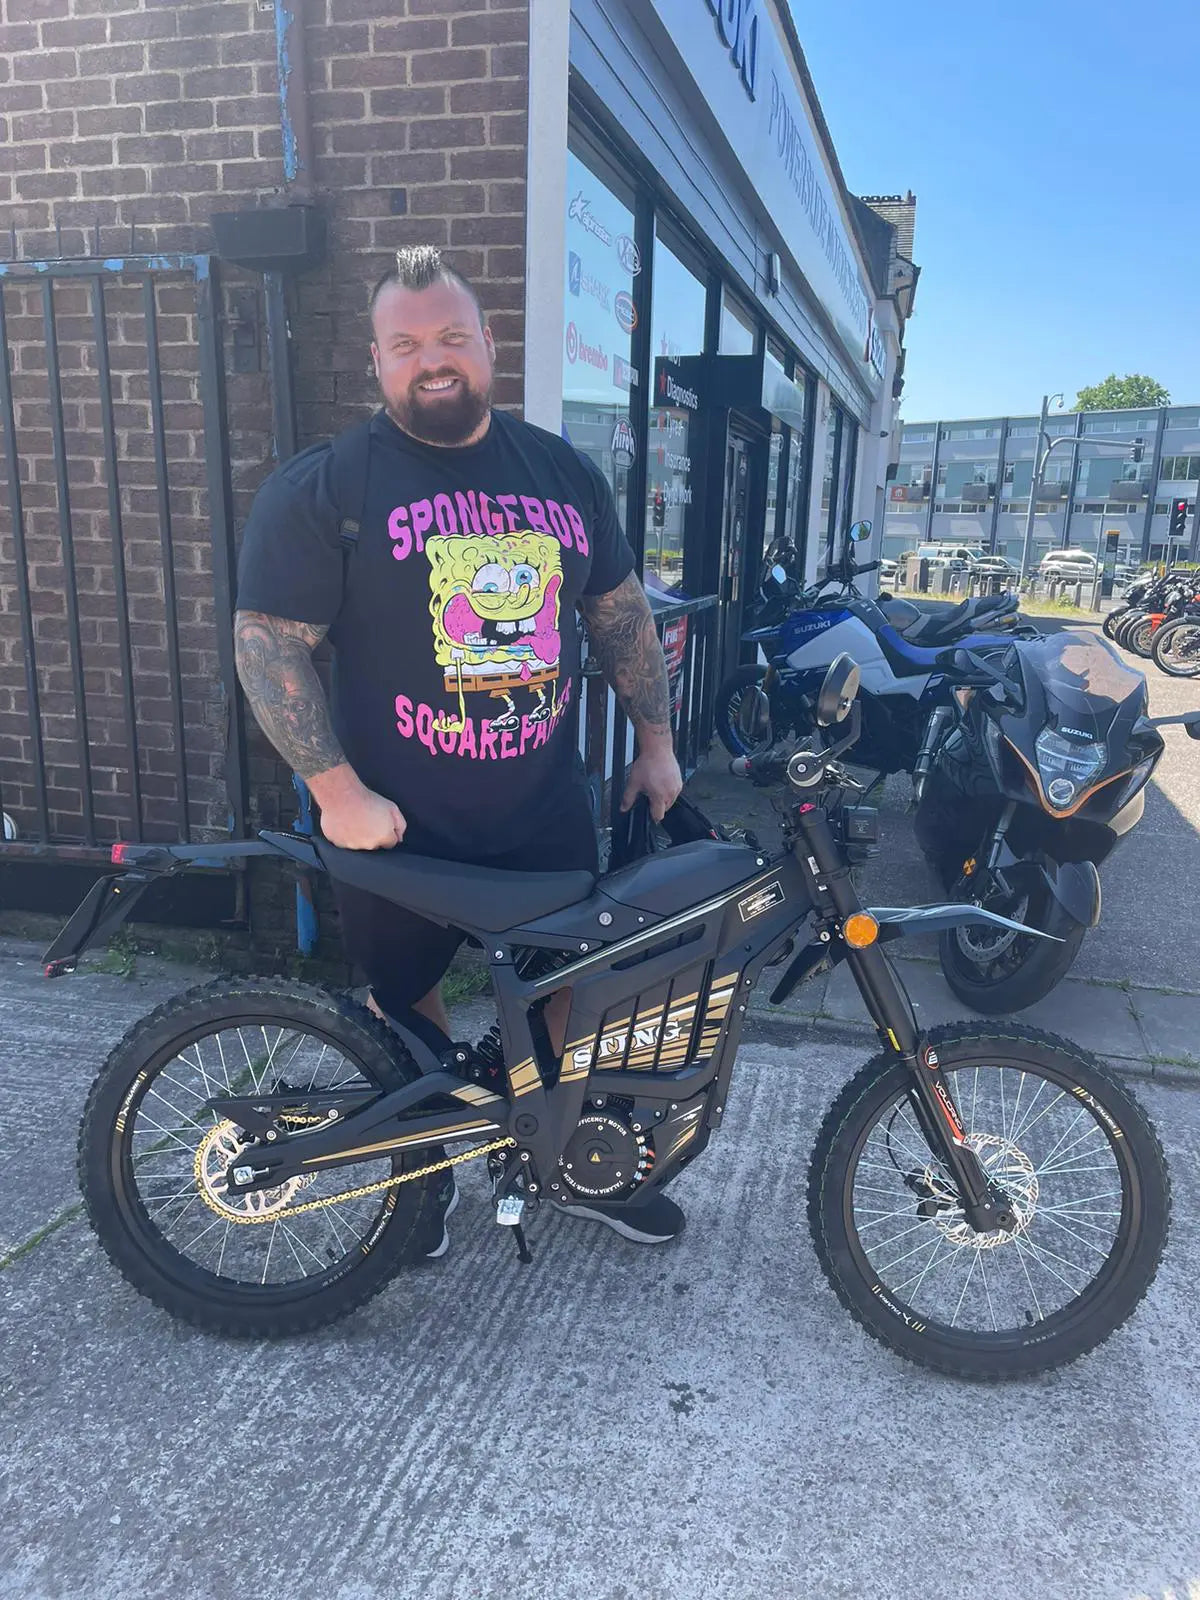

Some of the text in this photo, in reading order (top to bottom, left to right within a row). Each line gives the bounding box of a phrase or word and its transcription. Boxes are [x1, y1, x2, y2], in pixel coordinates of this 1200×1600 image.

[579, 334, 608, 372] brembo
[666, 375, 699, 410] Diagnostics
[388, 490, 589, 561] SPONGEBOB
[794, 620, 831, 635] SUZUKI
[1061, 726, 1093, 740] SUZUKI
[572, 1019, 682, 1070] STING
[935, 1080, 963, 1131] VOLCANO
[607, 1119, 627, 1137] MOTOR
[600, 1179, 625, 1195] TALARIA
